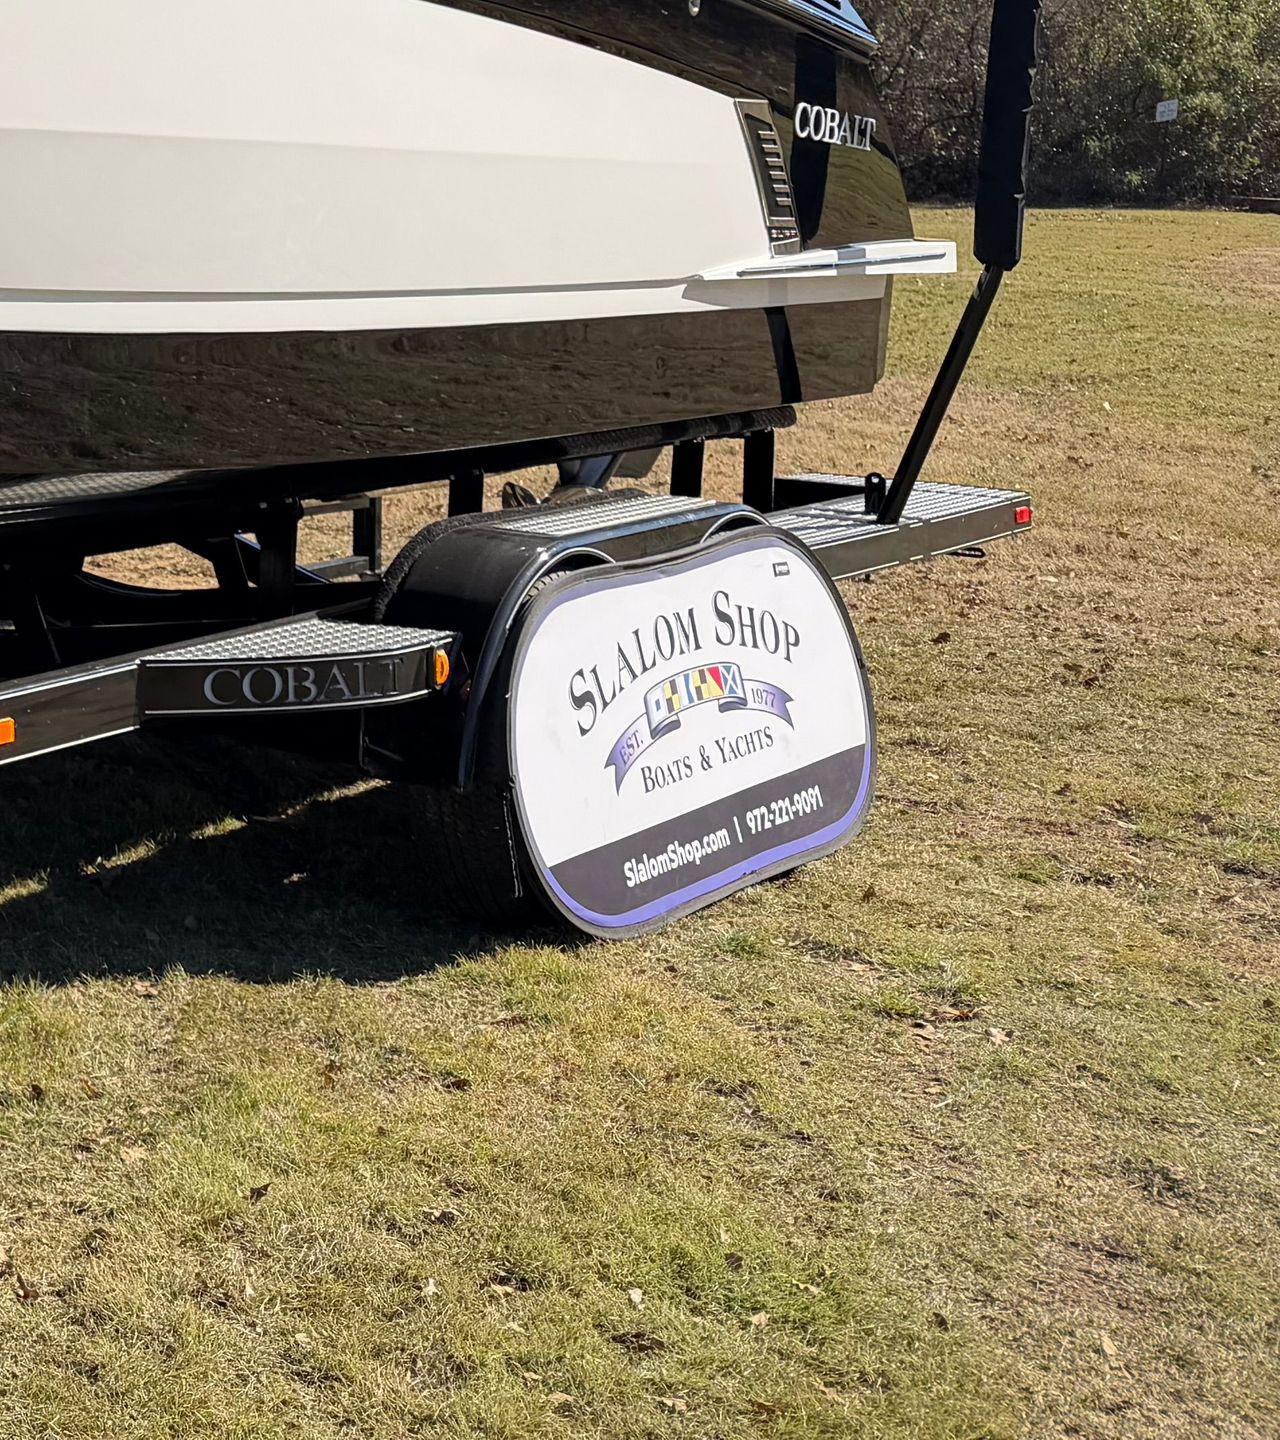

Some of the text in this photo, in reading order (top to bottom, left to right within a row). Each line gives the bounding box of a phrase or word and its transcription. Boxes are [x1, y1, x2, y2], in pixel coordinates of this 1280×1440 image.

[794, 101, 876, 151] COBALT
[203, 658, 406, 706] COBALT
[568, 590, 800, 737] SLALOM SHOP
[618, 687, 776, 767] EST. 1977
[641, 726, 774, 794] BOATS & YACHTS
[623, 825, 731, 888] SlalomShop.com
[746, 784, 824, 835] 972-221-9091
